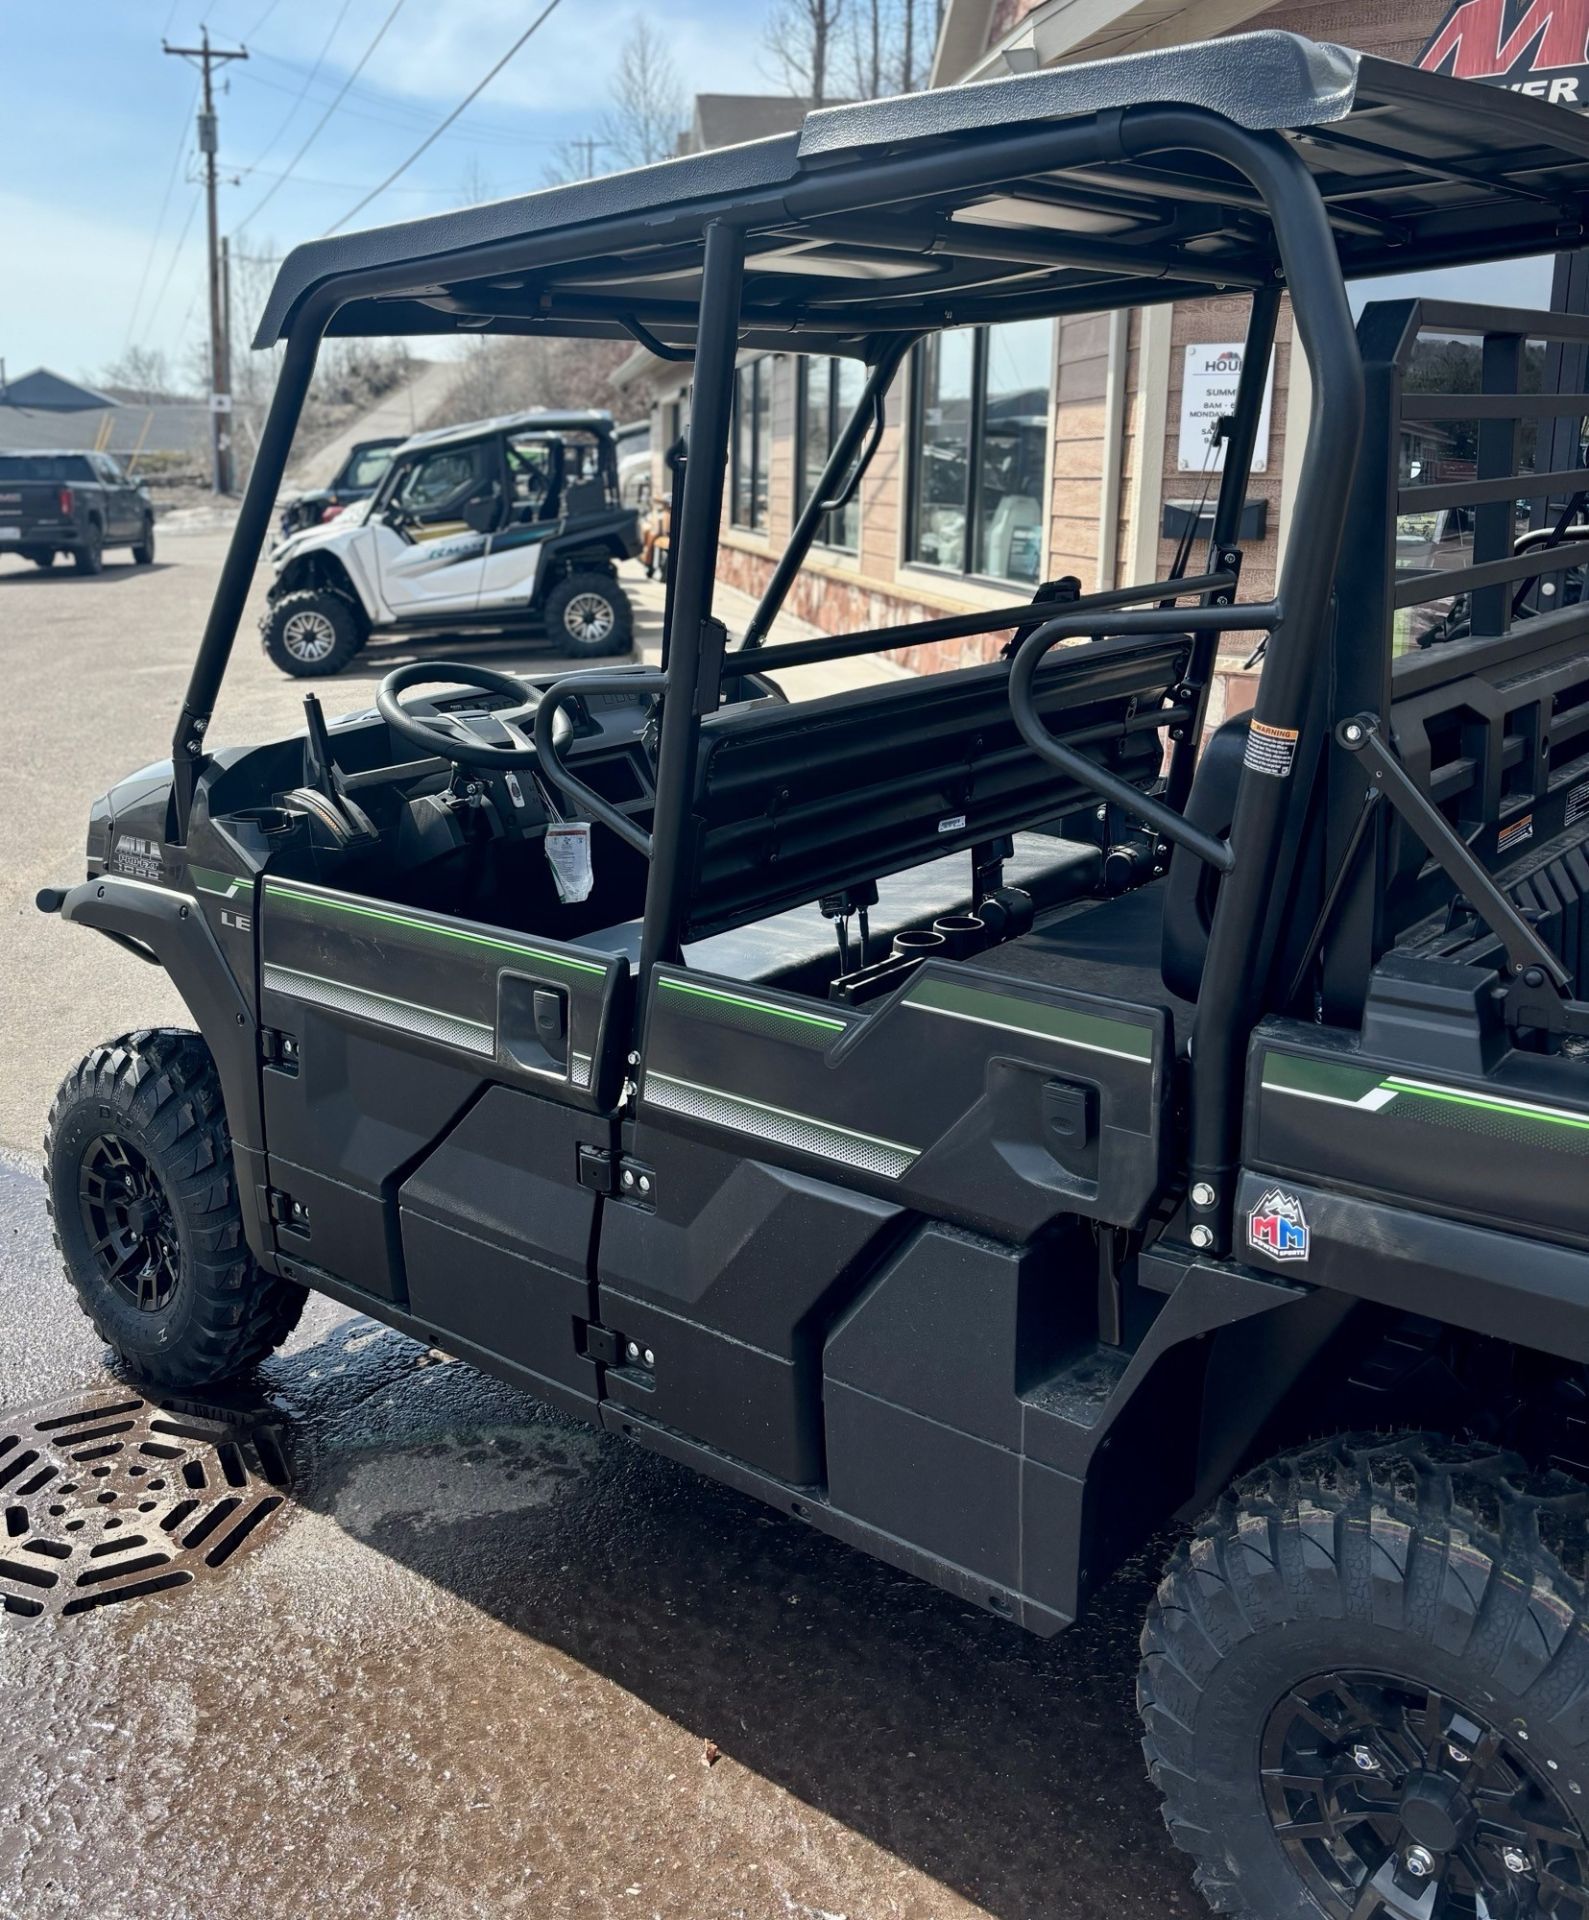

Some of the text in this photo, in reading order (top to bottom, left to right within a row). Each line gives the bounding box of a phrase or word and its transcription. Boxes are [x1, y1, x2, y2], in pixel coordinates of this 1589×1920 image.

[1205, 361, 1243, 372] HOU
[1256, 725, 1291, 738] WARNING
[114, 834, 163, 863] MULE
[221, 911, 251, 932] LE
